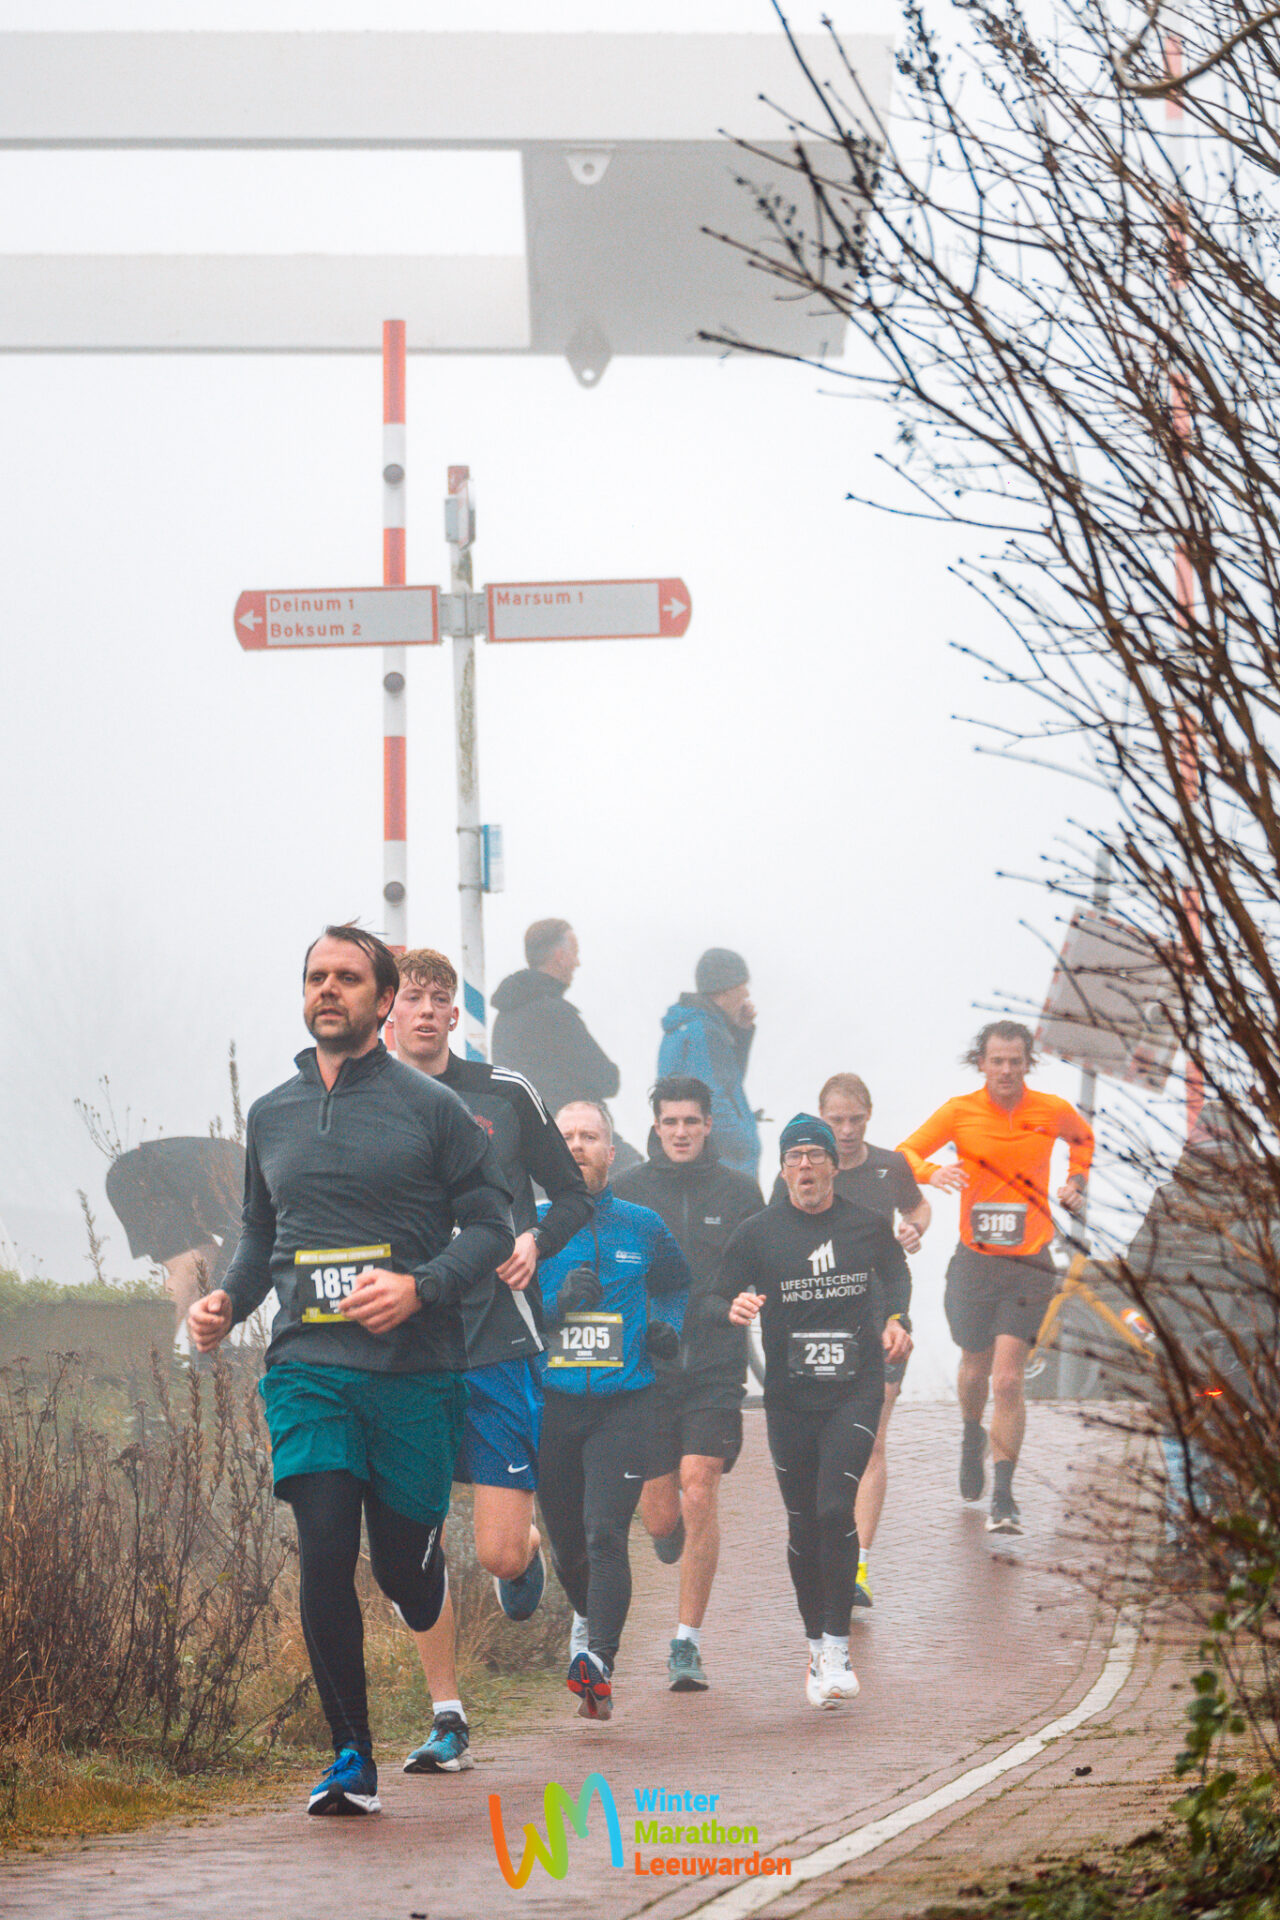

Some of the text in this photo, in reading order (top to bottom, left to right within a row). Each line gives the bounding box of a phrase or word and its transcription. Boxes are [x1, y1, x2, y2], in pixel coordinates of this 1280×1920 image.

[270, 597, 354, 612] Deinum 1
[497, 591, 583, 605] Marsum 1
[271, 622, 361, 637] Boksum 2
[782, 1290, 813, 1303] MIND
[814, 1288, 825, 1300] &
[560, 1326, 610, 1350] 1205
[804, 1342, 845, 1365] 235
